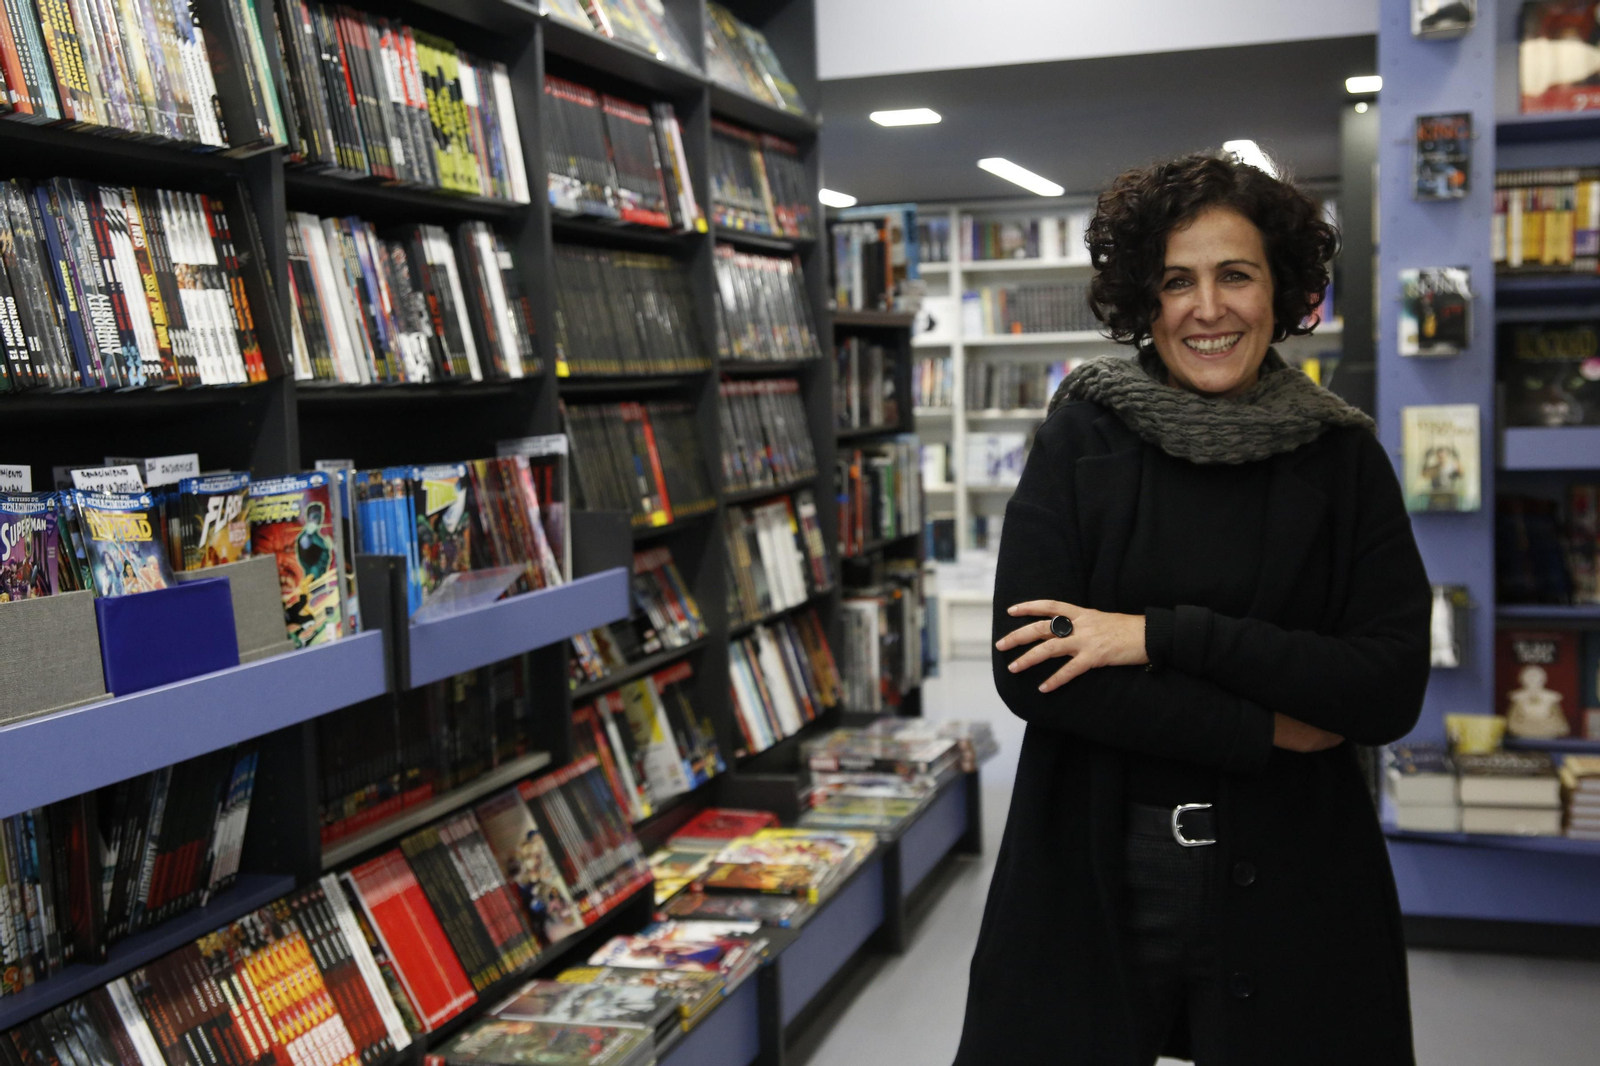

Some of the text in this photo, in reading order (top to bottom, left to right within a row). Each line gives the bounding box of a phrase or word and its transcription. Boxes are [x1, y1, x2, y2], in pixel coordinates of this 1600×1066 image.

[54, 0, 83, 92] ANIMAL MAN
[57, 37, 76, 90] ANIMAL
[61, 2, 91, 94] ANIMAL MAN
[5, 296, 29, 361] EL MONSTRUO
[86, 293, 113, 354] AUTHORITY
[97, 293, 123, 355] AUTHORITY
[9, 349, 19, 361] EL
[1, 502, 45, 512] RENACIMIENTO
[86, 497, 140, 509] RENACIMIENTO
[1, 518, 47, 562] SUPERMAN
[137, 842, 159, 904] AUTHORITY
